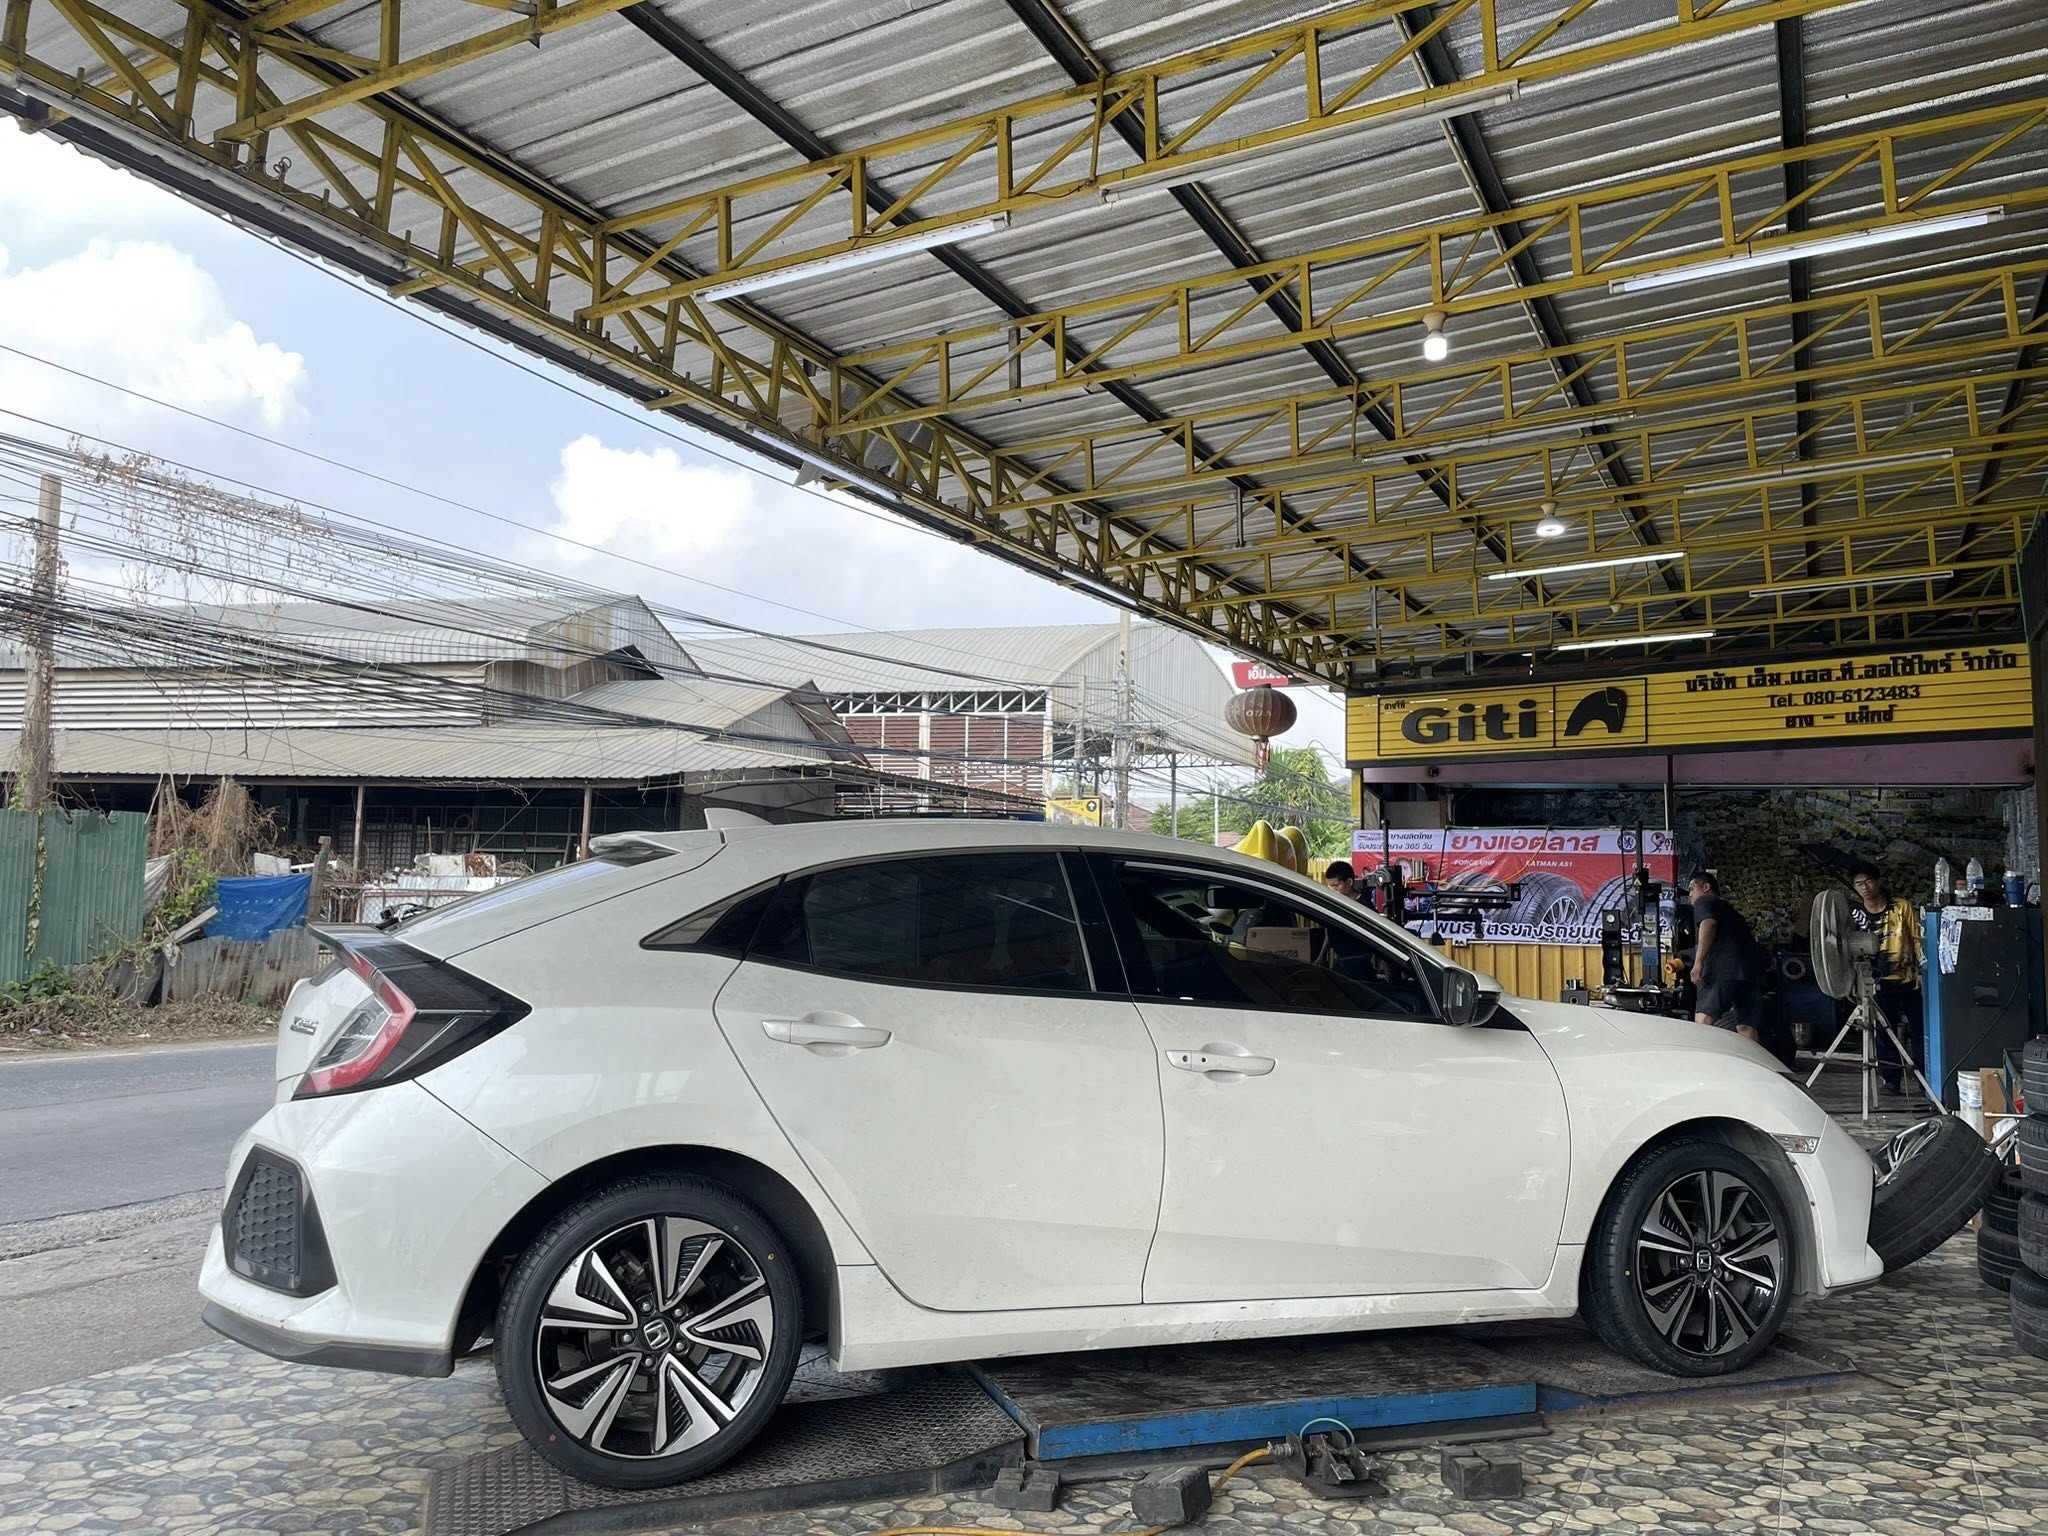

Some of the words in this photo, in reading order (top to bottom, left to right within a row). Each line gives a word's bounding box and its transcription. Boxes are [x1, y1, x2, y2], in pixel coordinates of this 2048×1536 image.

[1767, 693, 1799, 708] Tel.
[1803, 684, 1921, 706] 080-6123483
[1401, 699, 1537, 744] Giti
[1785, 714, 1815, 728] ยาง
[1451, 835, 1600, 851] ยางแอตลาส
